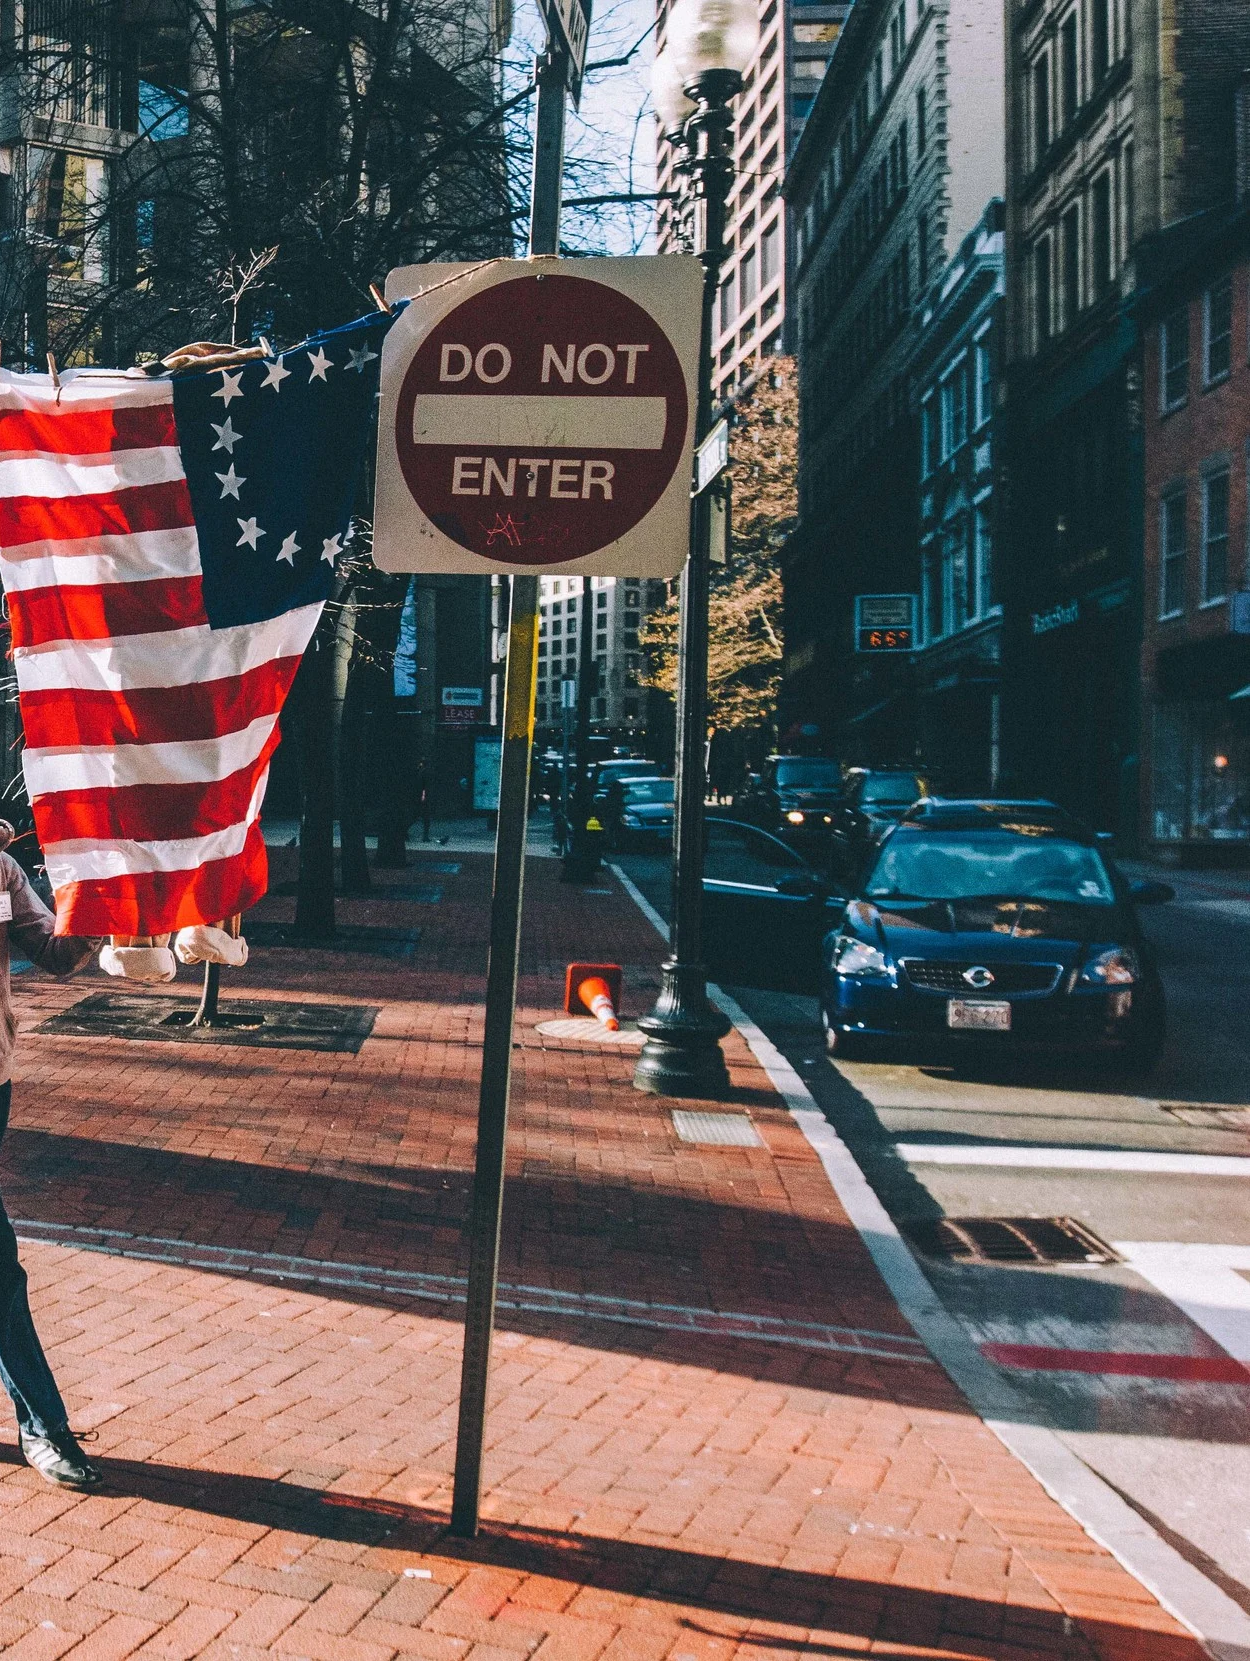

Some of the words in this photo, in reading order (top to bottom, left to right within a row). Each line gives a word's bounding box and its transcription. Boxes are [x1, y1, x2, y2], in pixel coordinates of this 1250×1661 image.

[439, 342, 512, 384] DO
[541, 342, 649, 385] NOT
[451, 456, 616, 500] ENTER
[445, 709, 475, 719] LEASE
